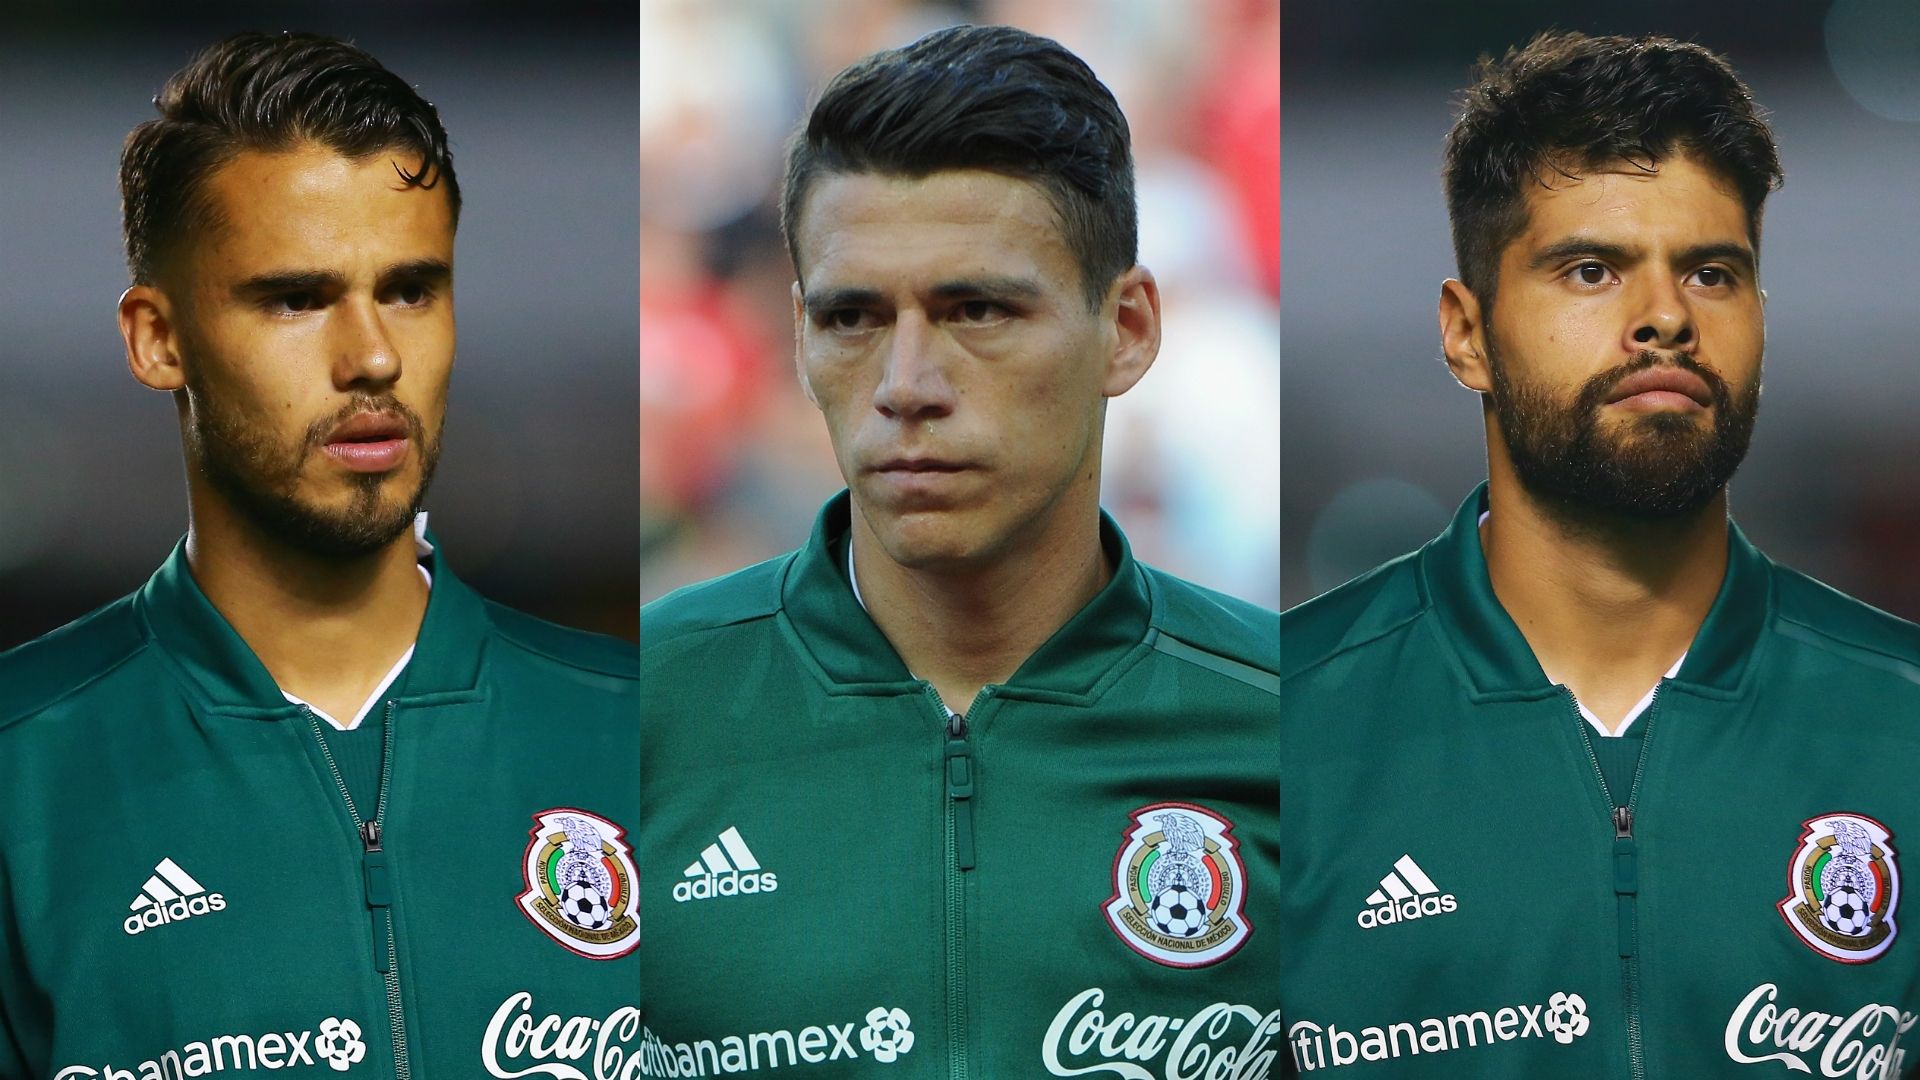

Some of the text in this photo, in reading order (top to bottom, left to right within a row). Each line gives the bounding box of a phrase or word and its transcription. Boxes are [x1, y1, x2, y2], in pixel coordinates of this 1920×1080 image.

[673, 869, 778, 902] adidas
[1130, 864, 1139, 892] PASIÓN
[1221, 871, 1230, 906] ORGULLO
[124, 893, 227, 935] adidas
[1122, 911, 1232, 949] SELECCIÓN NACIONAL DE MÉXICO
[1357, 894, 1458, 929] adidas
[640, 1022, 858, 1079] citibanamex
[1042, 987, 1280, 1080] Coca-Cola
[1288, 1004, 1544, 1073] itibanamex
